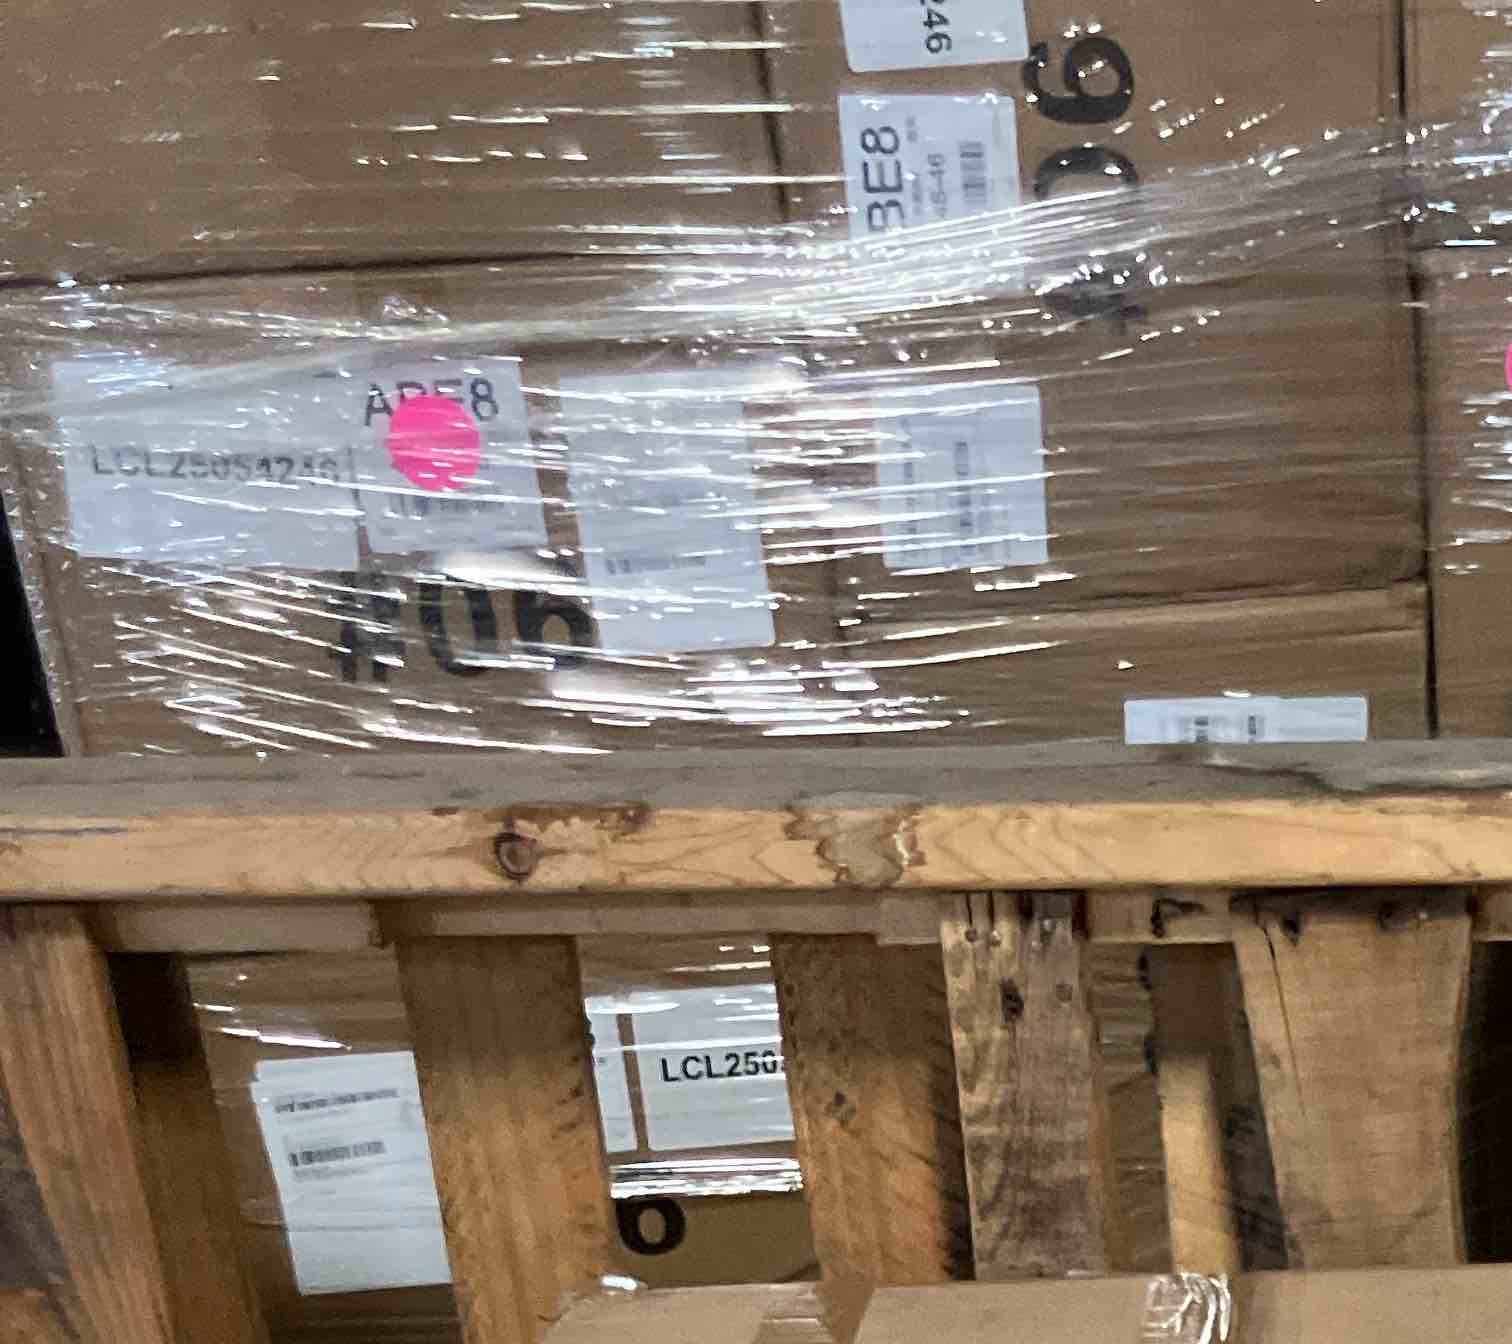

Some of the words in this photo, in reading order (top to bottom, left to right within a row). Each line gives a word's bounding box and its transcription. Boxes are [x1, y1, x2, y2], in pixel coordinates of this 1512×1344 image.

[921, 0, 951, 53] 46
[861, 126, 904, 232] BE8
[661, 1051, 785, 1082] LCL250
